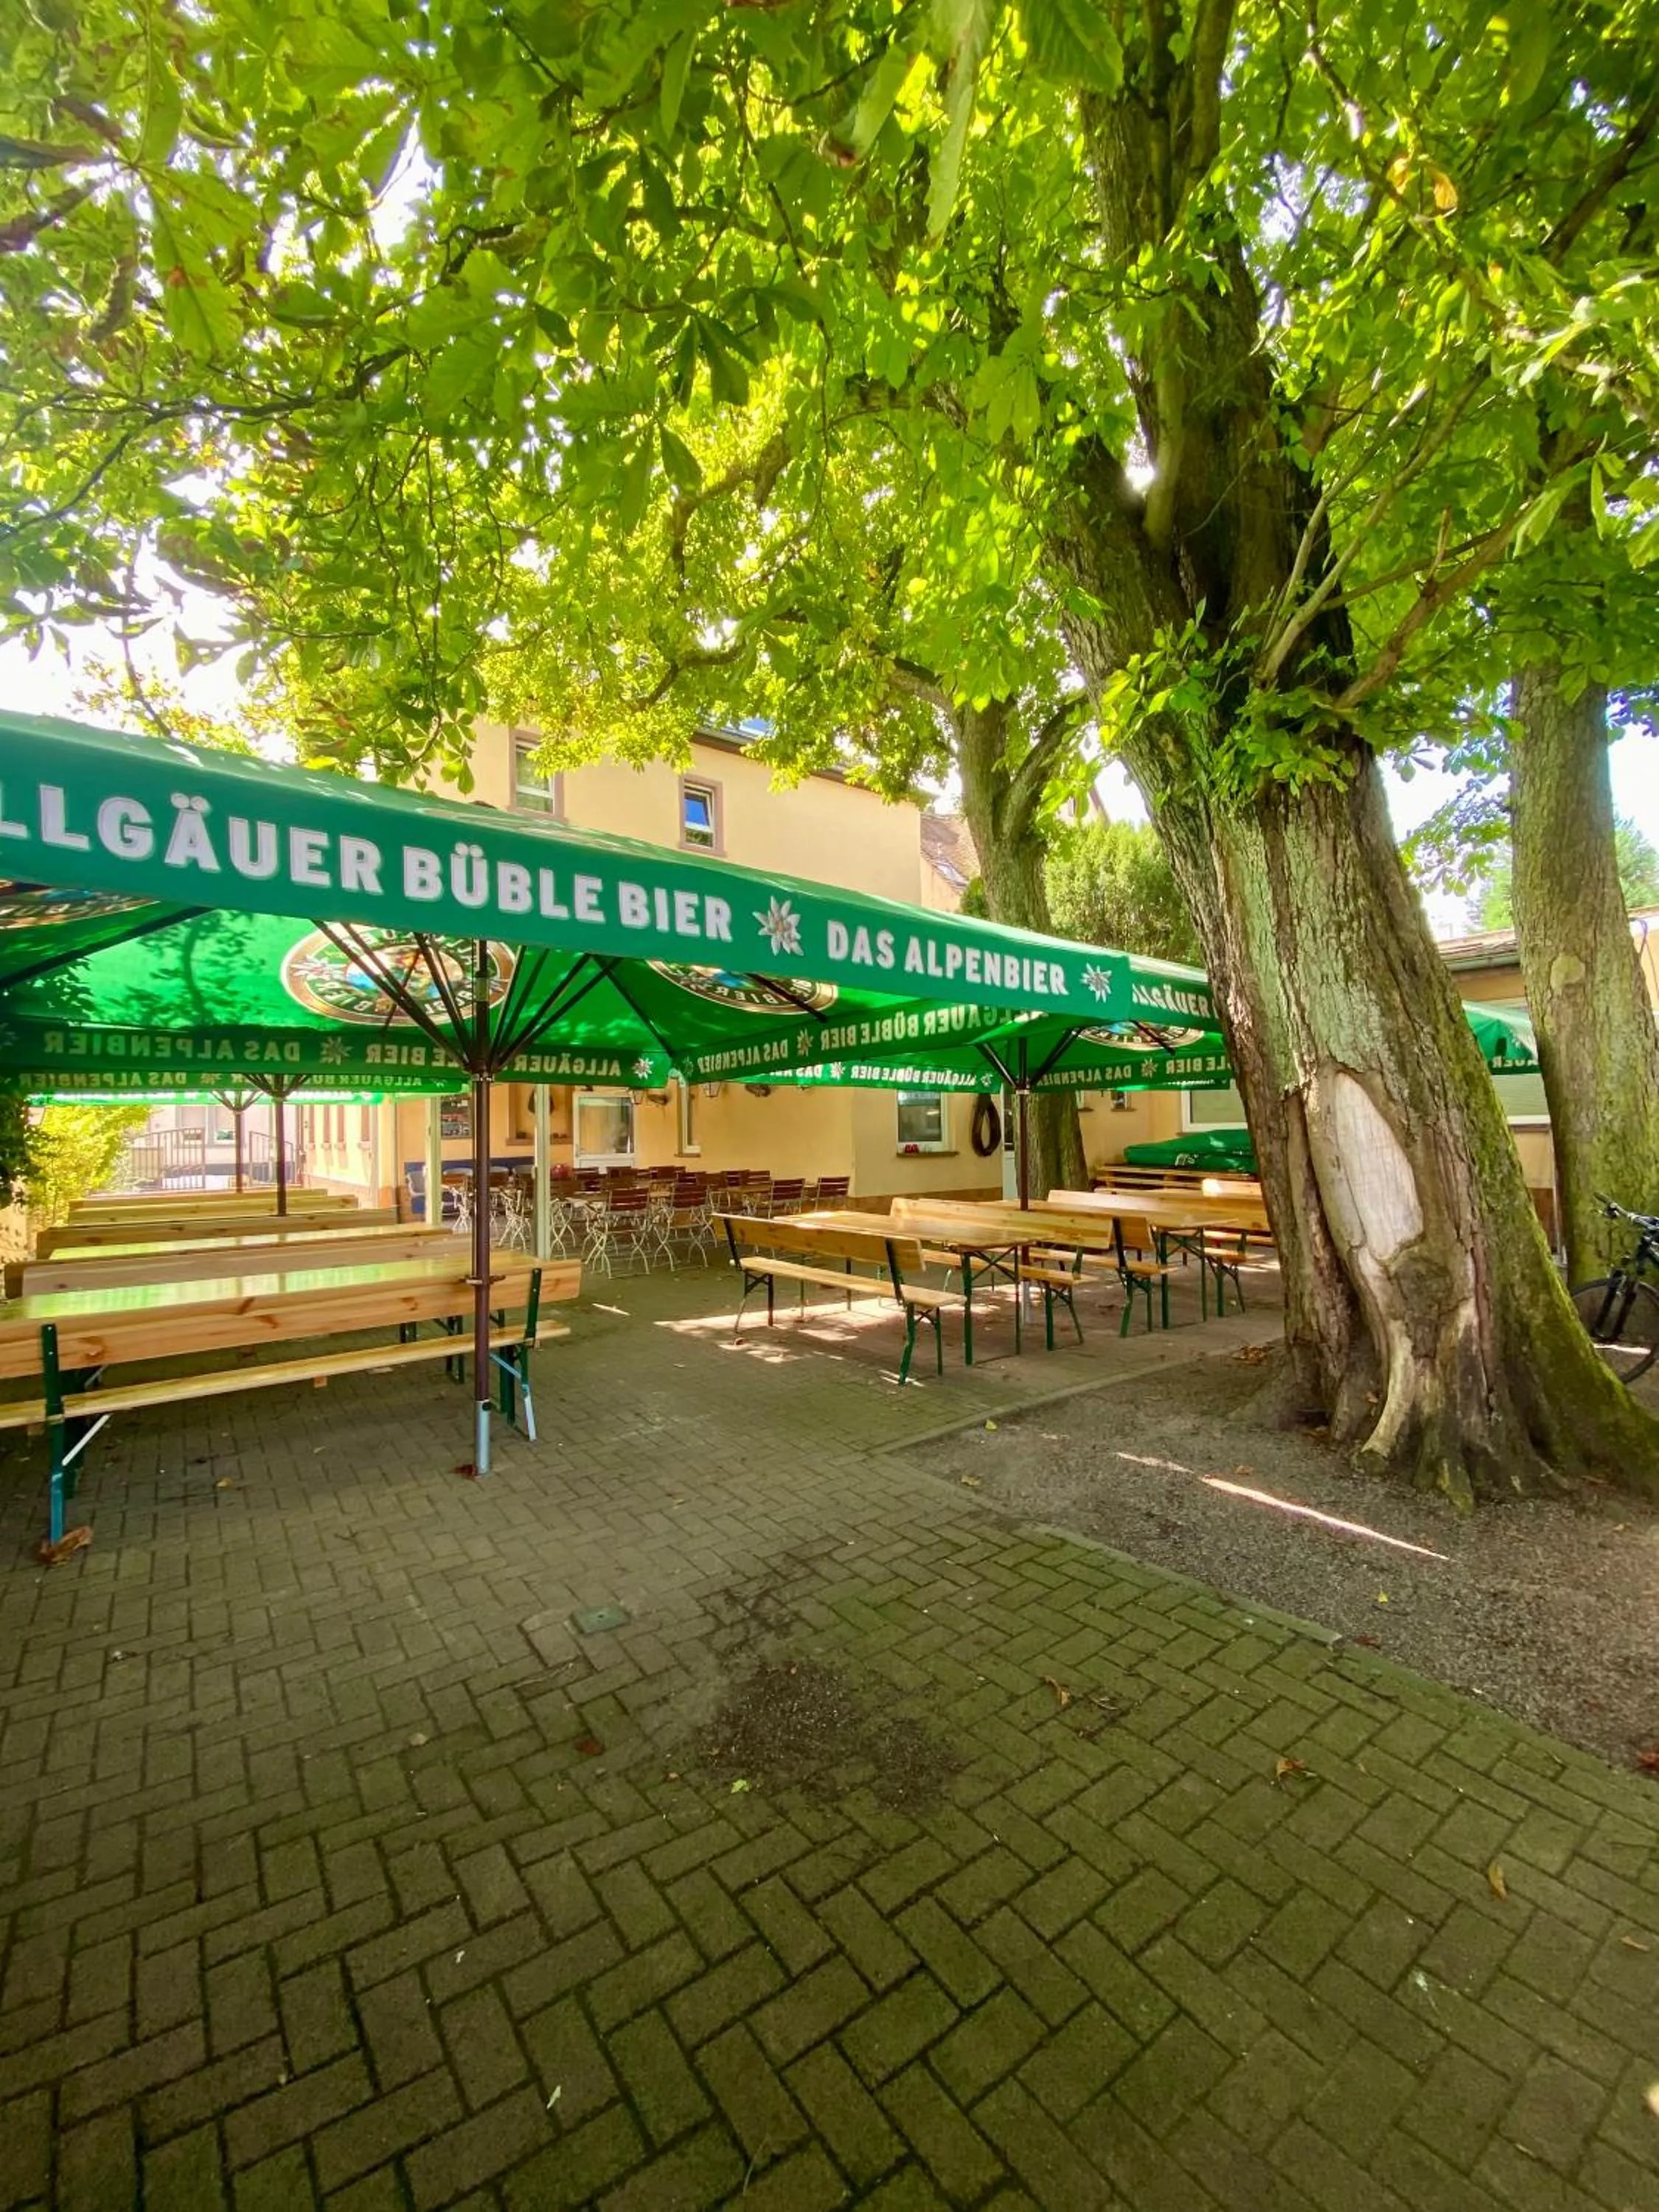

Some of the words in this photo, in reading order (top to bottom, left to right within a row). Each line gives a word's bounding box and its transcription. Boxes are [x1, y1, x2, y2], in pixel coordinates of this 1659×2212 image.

[403, 843, 606, 924] BÜBLE
[619, 880, 733, 943] BIER
[827, 919, 896, 969] DAS
[905, 934, 1068, 997] ALPENBIER
